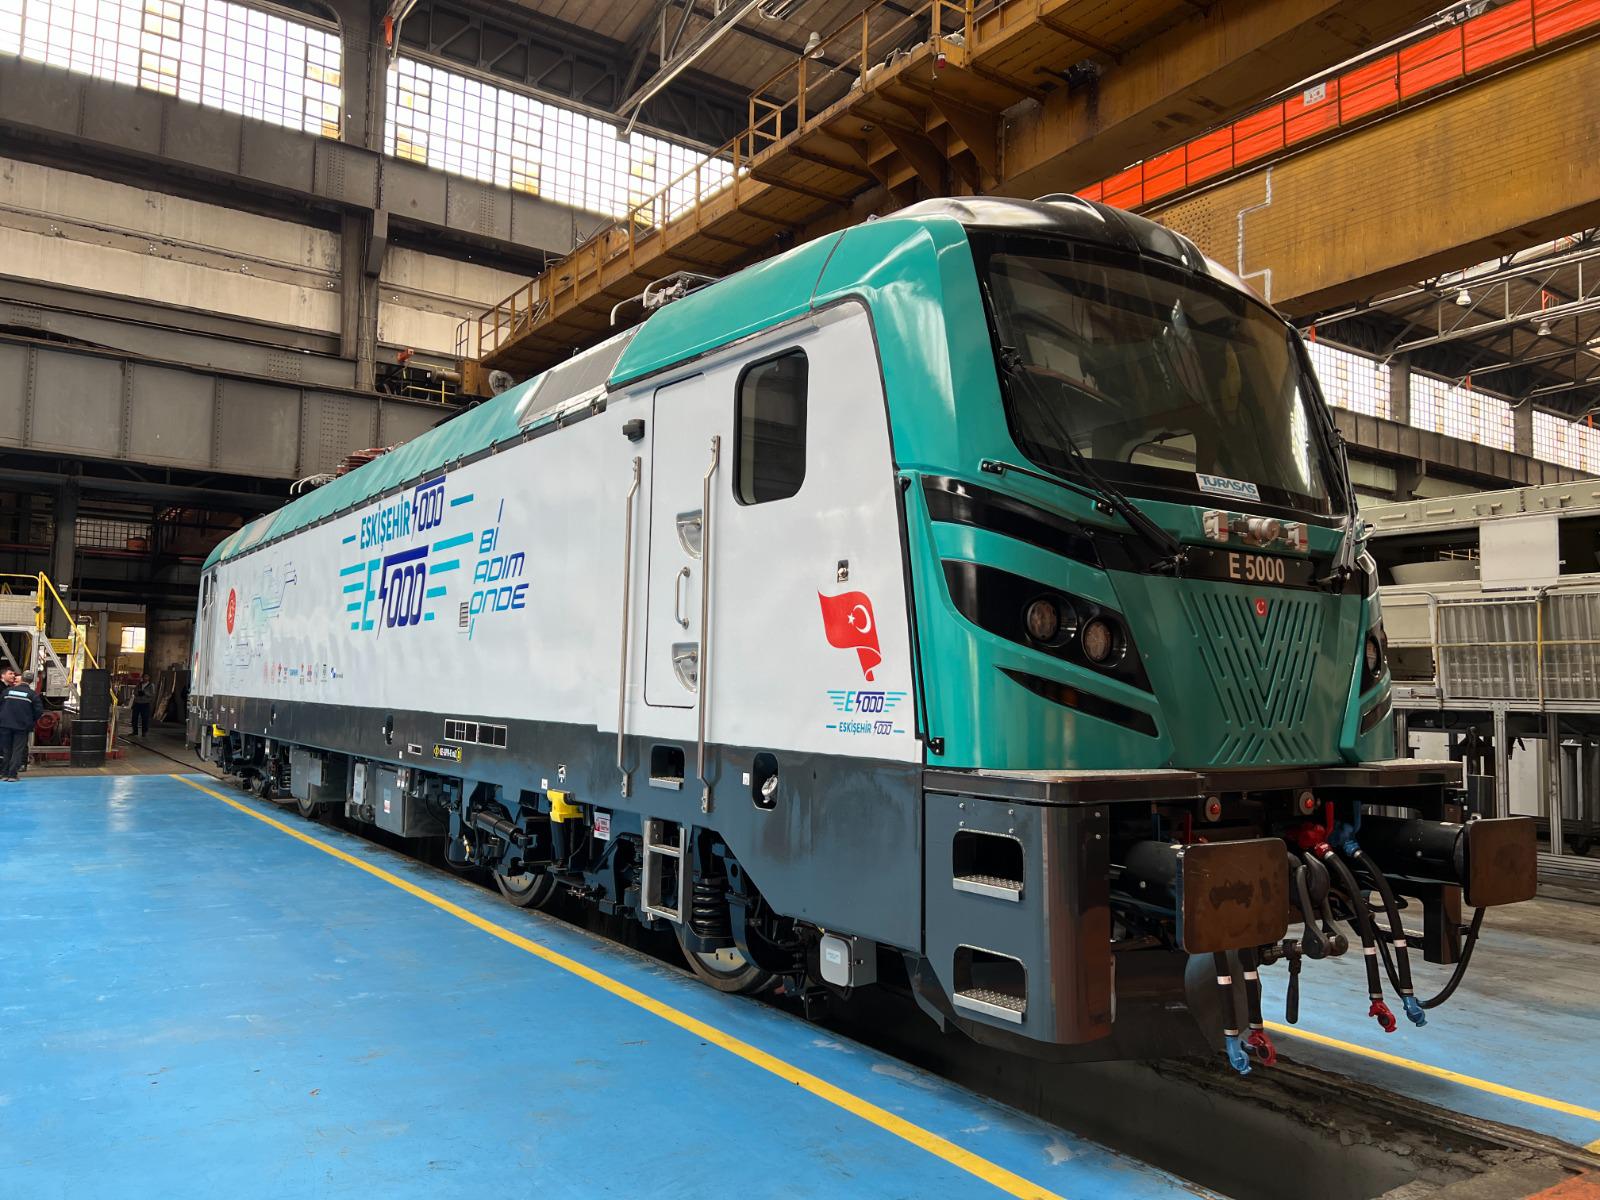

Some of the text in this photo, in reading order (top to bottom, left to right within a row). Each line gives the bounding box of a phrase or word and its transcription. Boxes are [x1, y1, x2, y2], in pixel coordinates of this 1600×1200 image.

[360, 475, 446, 552] ESKİŞEHİR 5000
[473, 551, 525, 584] ADIM
[1228, 552, 1285, 584] E 5000
[839, 719, 893, 735] ESKİŞEHİR 5000
